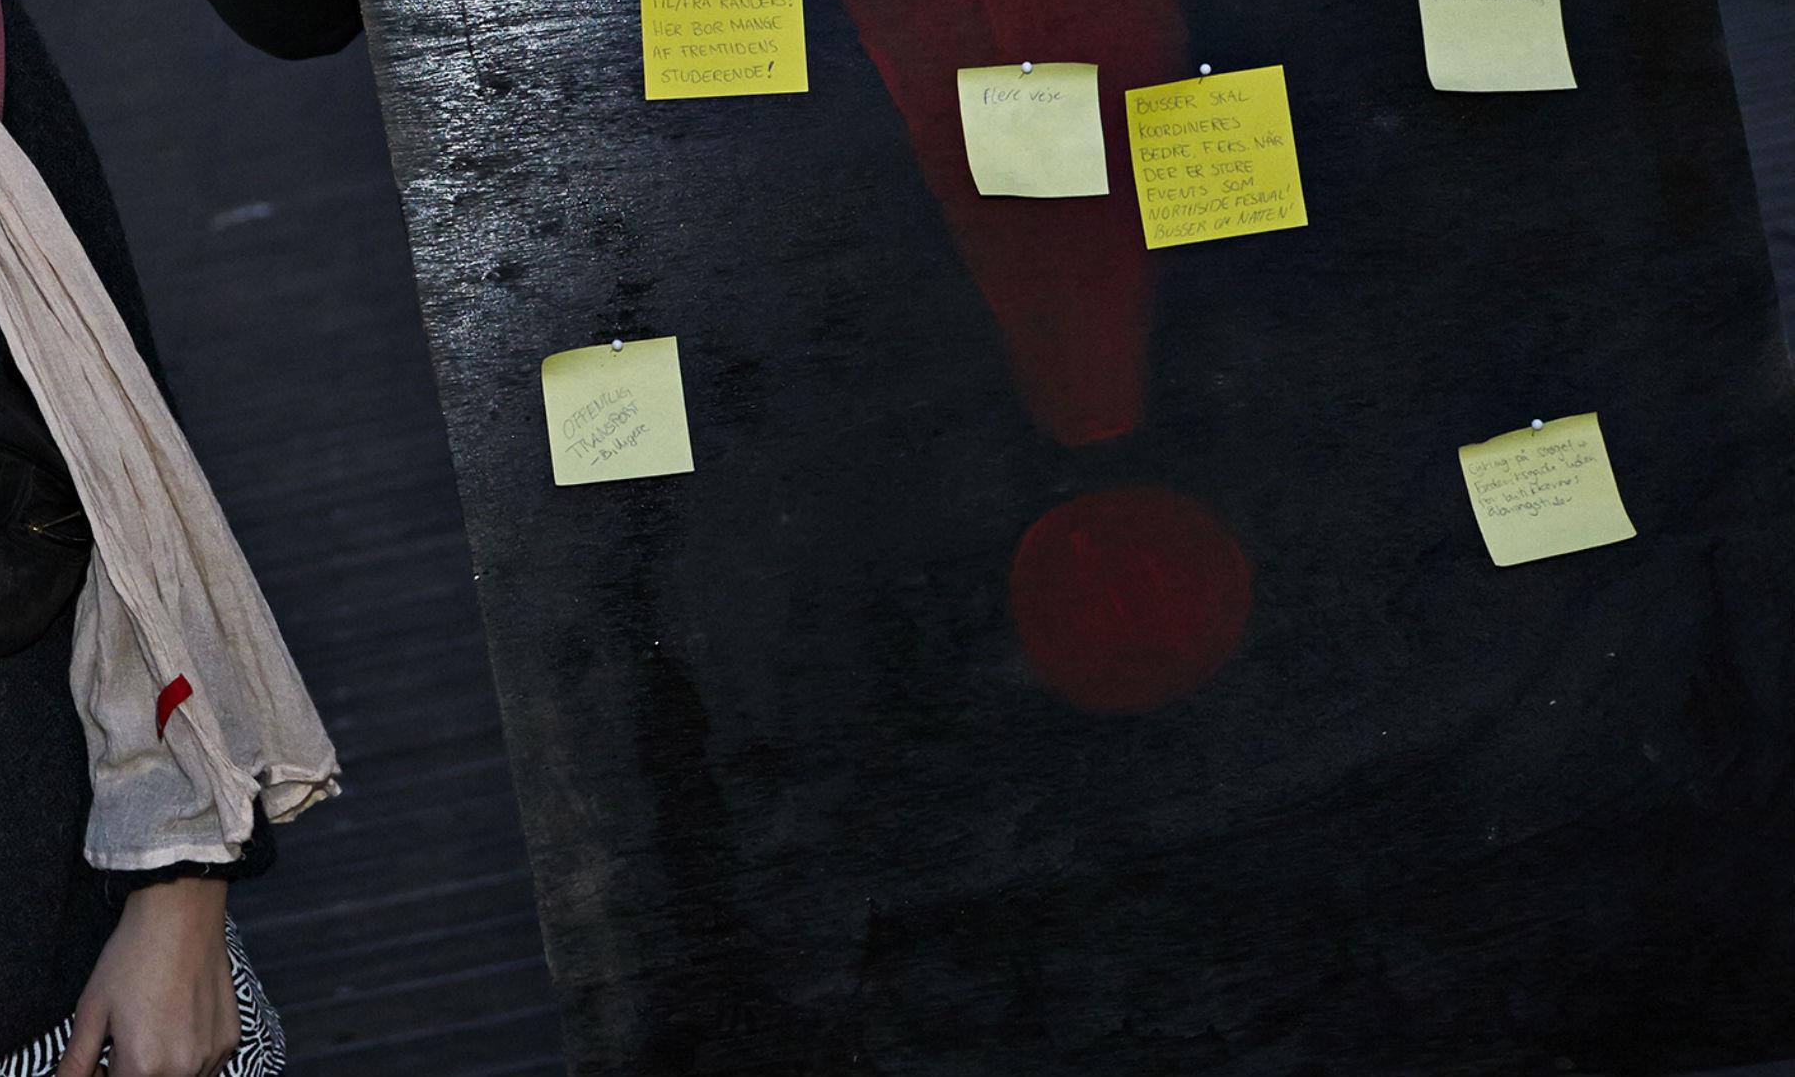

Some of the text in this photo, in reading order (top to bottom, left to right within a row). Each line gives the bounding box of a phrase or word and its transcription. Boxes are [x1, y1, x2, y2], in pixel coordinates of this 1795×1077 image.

[652, 15, 783, 37] HER BOR MANGE
[653, 39, 779, 60] AF FREMTIDENS
[661, 60, 777, 85] STUDERENDE!
[1135, 90, 1250, 115] BUSSER SKAL
[1138, 116, 1242, 139] KOORDINERES
[1254, 130, 1285, 150] NÅR
[1143, 160, 1254, 183] DER ER STORE
[1146, 176, 1254, 203] EVENTS SOM
[1148, 196, 1230, 221] NORTHSIDE
[1154, 218, 1207, 239] BUSSER
[562, 386, 635, 440] OFFENTLIG
[565, 399, 640, 459] TRANSPORT
